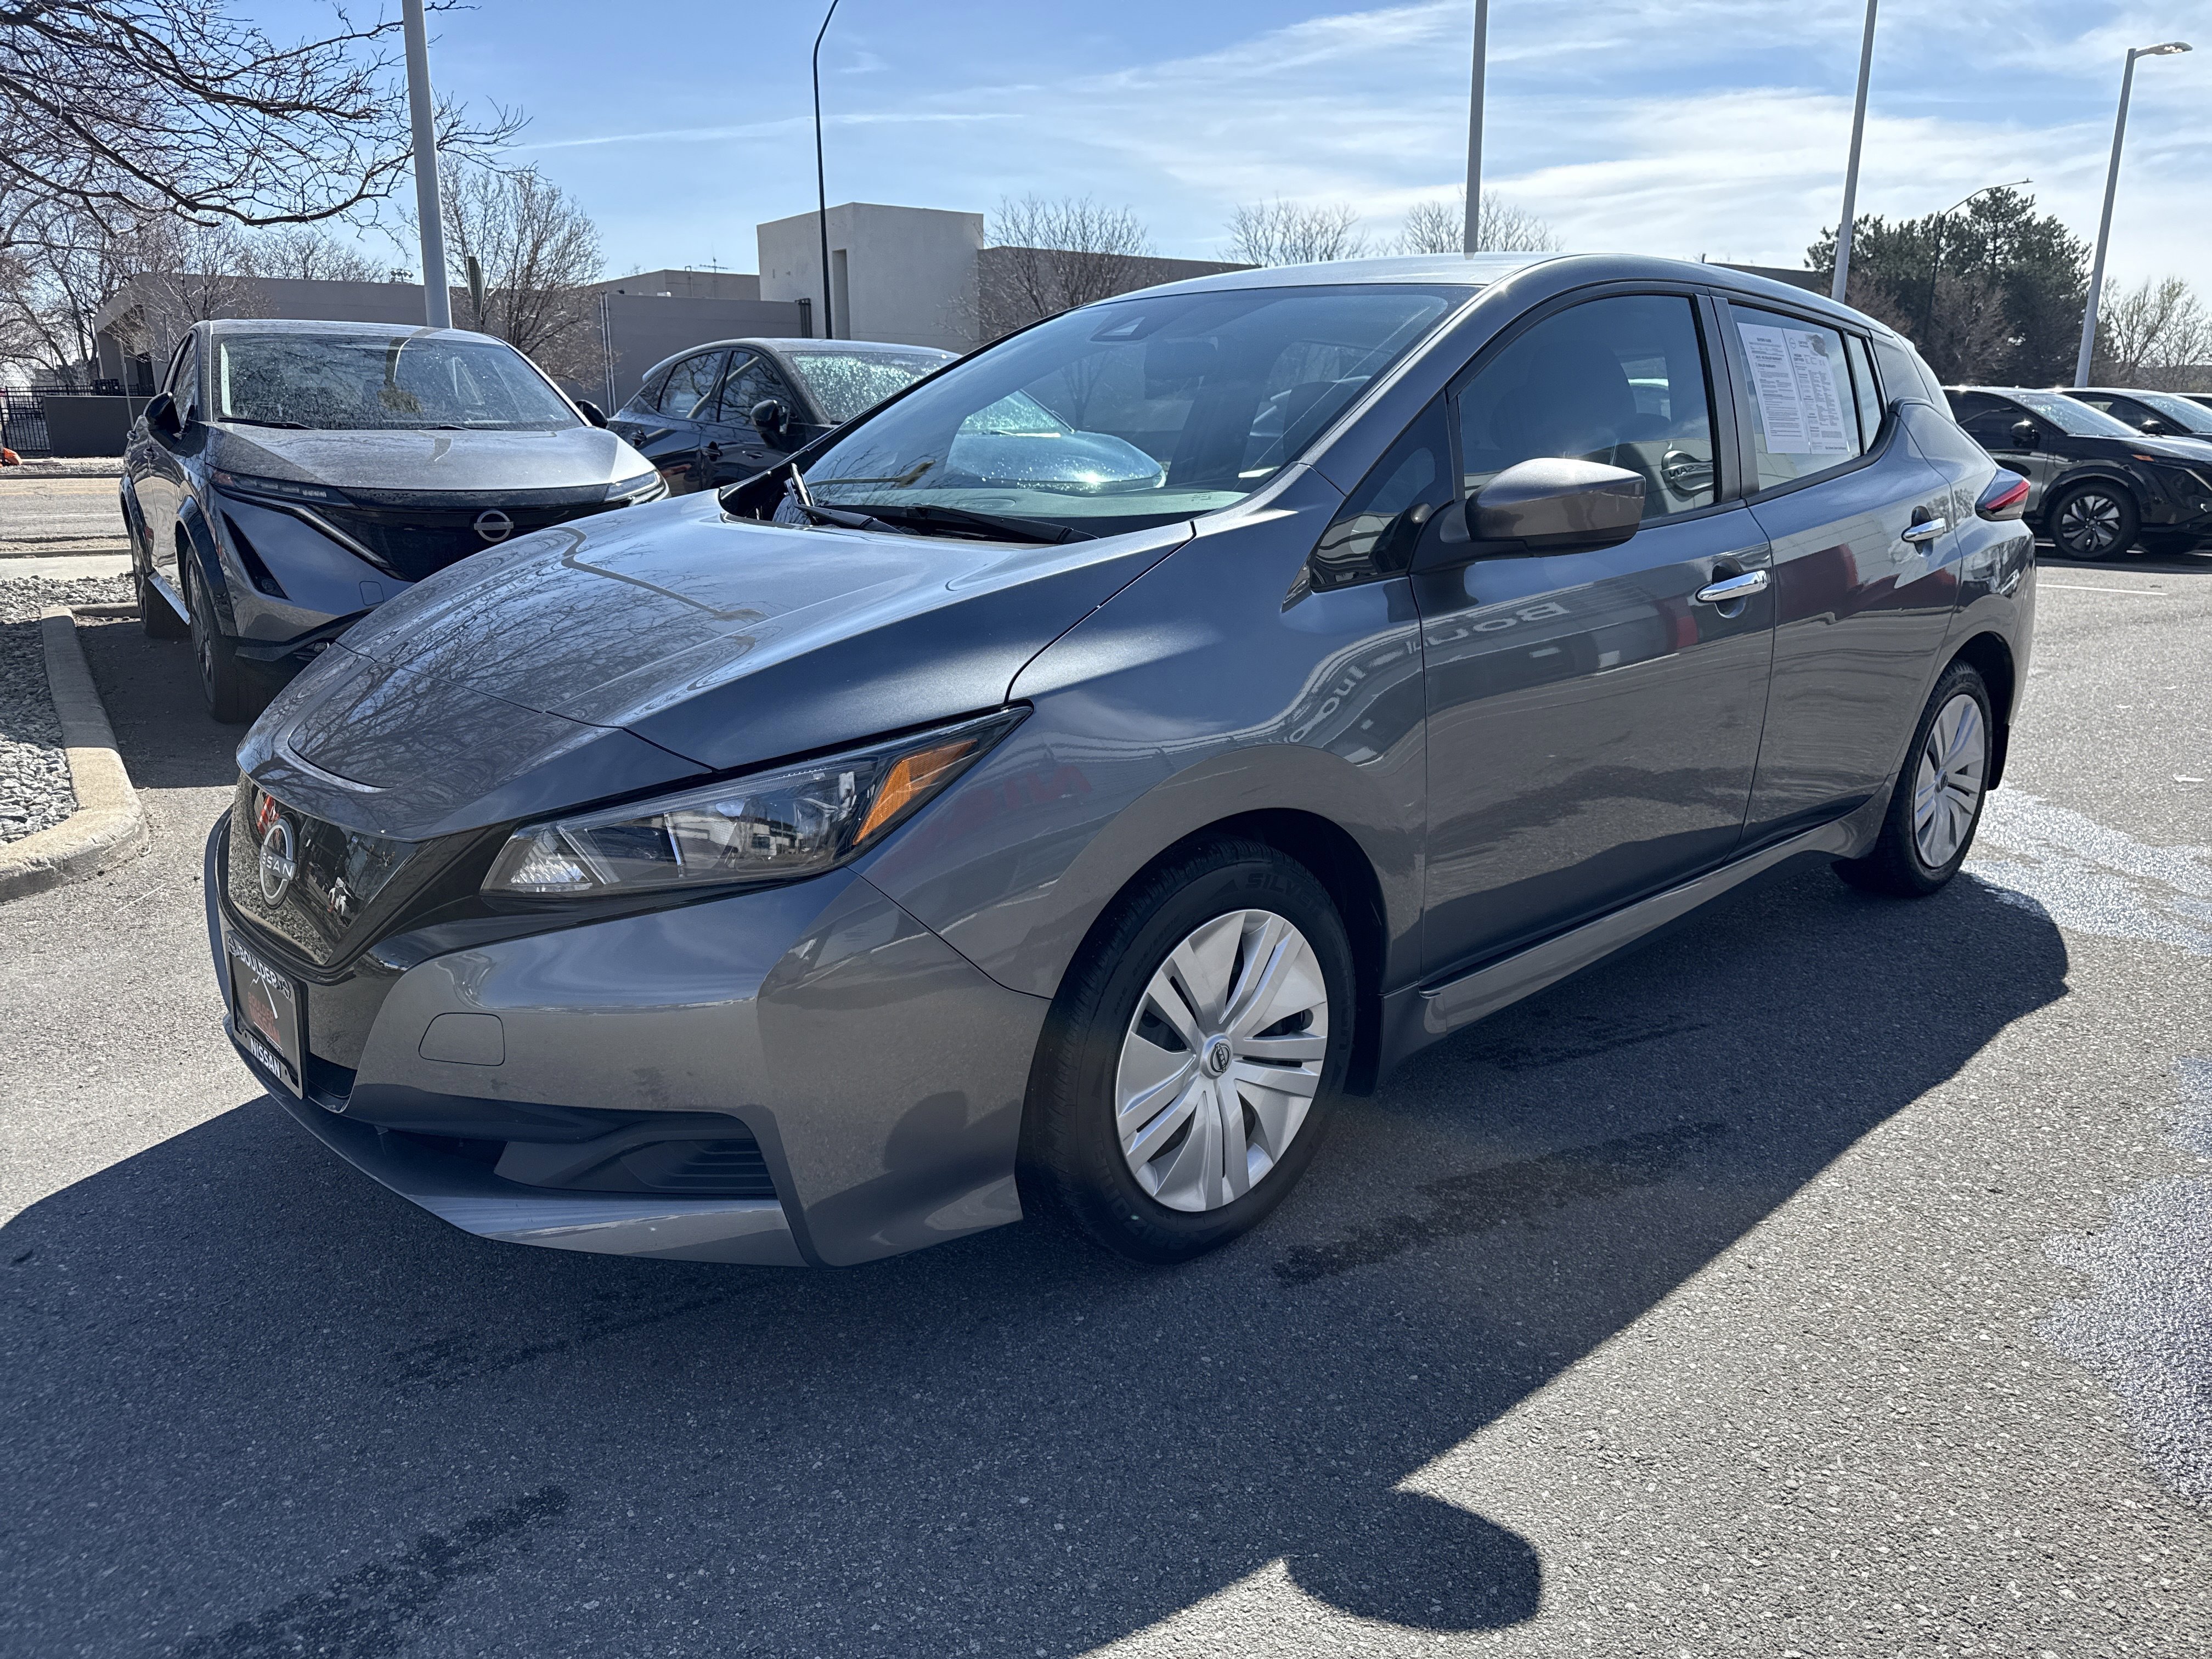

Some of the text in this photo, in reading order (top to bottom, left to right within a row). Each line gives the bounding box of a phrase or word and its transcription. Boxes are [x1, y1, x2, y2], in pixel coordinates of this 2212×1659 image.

[262, 852, 294, 877] SSAN
[239, 944, 277, 986] BOULDER
[250, 1037, 281, 1079] NISSAN
